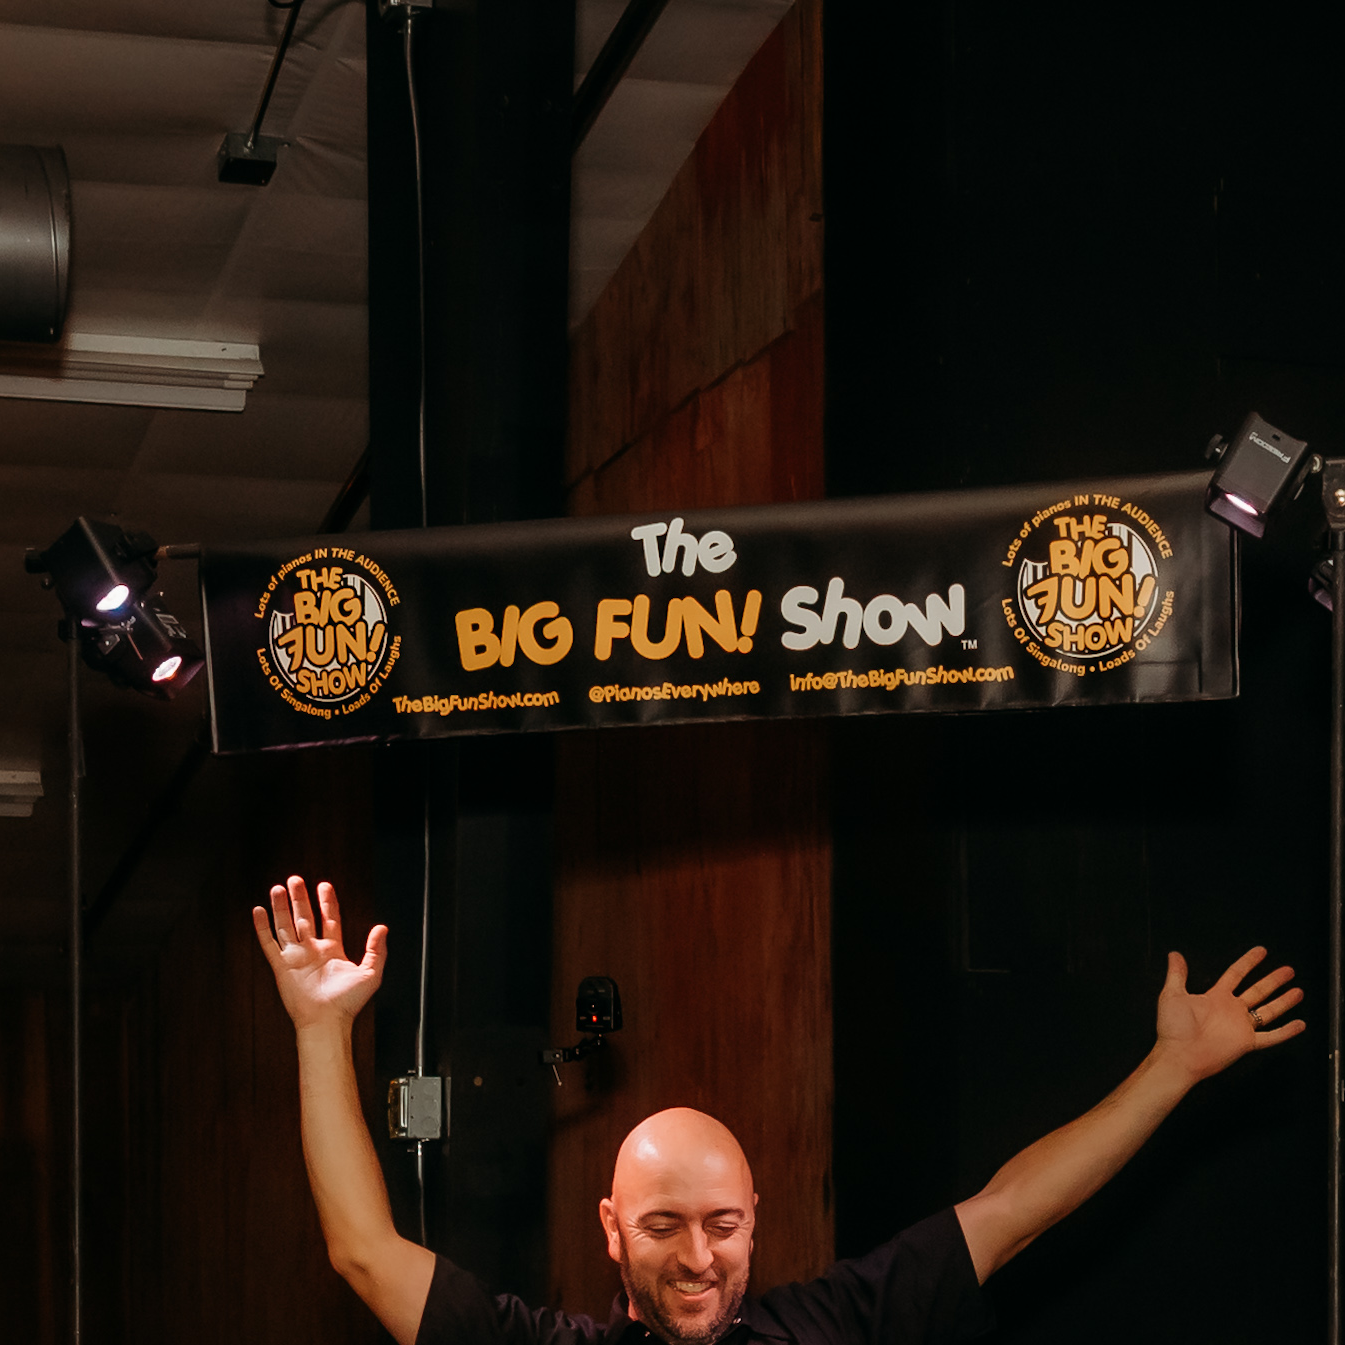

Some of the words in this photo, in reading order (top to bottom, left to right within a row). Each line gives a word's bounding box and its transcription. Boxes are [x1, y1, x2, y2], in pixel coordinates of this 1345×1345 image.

[631, 517, 738, 577] The
[1002, 539, 1022, 567] Lots
[1020, 522, 1032, 538] of
[1032, 500, 1071, 528] pianos
[1074, 495, 1089, 506] IN
[1093, 494, 1121, 509] THE
[1121, 502, 1173, 559] AUDIENCE
[1054, 515, 1107, 541] THE
[296, 567, 343, 591] THE
[1049, 538, 1129, 579] BIG
[254, 592, 271, 618] Lots
[268, 575, 279, 591] of
[277, 553, 313, 581] pianos
[314, 548, 328, 559] IN
[331, 547, 355, 561] THE
[355, 554, 401, 607] AUDIENCE
[294, 588, 362, 627] BIG
[455, 601, 573, 672] BIG
[594, 589, 762, 661] FUN!
[781, 577, 965, 650] Show
[1001, 598, 1017, 628] Lots
[1014, 628, 1031, 644] Of
[1026, 642, 1086, 676] Singalong
[1099, 650, 1136, 672] Loads
[1135, 634, 1151, 650] Of
[1148, 590, 1175, 636] Laughs
[1044, 617, 1133, 651] SHOW
[256, 648, 271, 675] Lots
[269, 675, 284, 690] Of
[280, 688, 332, 720] Singalong
[342, 694, 371, 715] Loads
[369, 677, 383, 693] Of
[379, 635, 402, 679] Laughs
[296, 662, 366, 696] SHOW
[392, 690, 560, 716] TheBigFunShow.com
[588, 676, 761, 703] @PianosEverywhere
